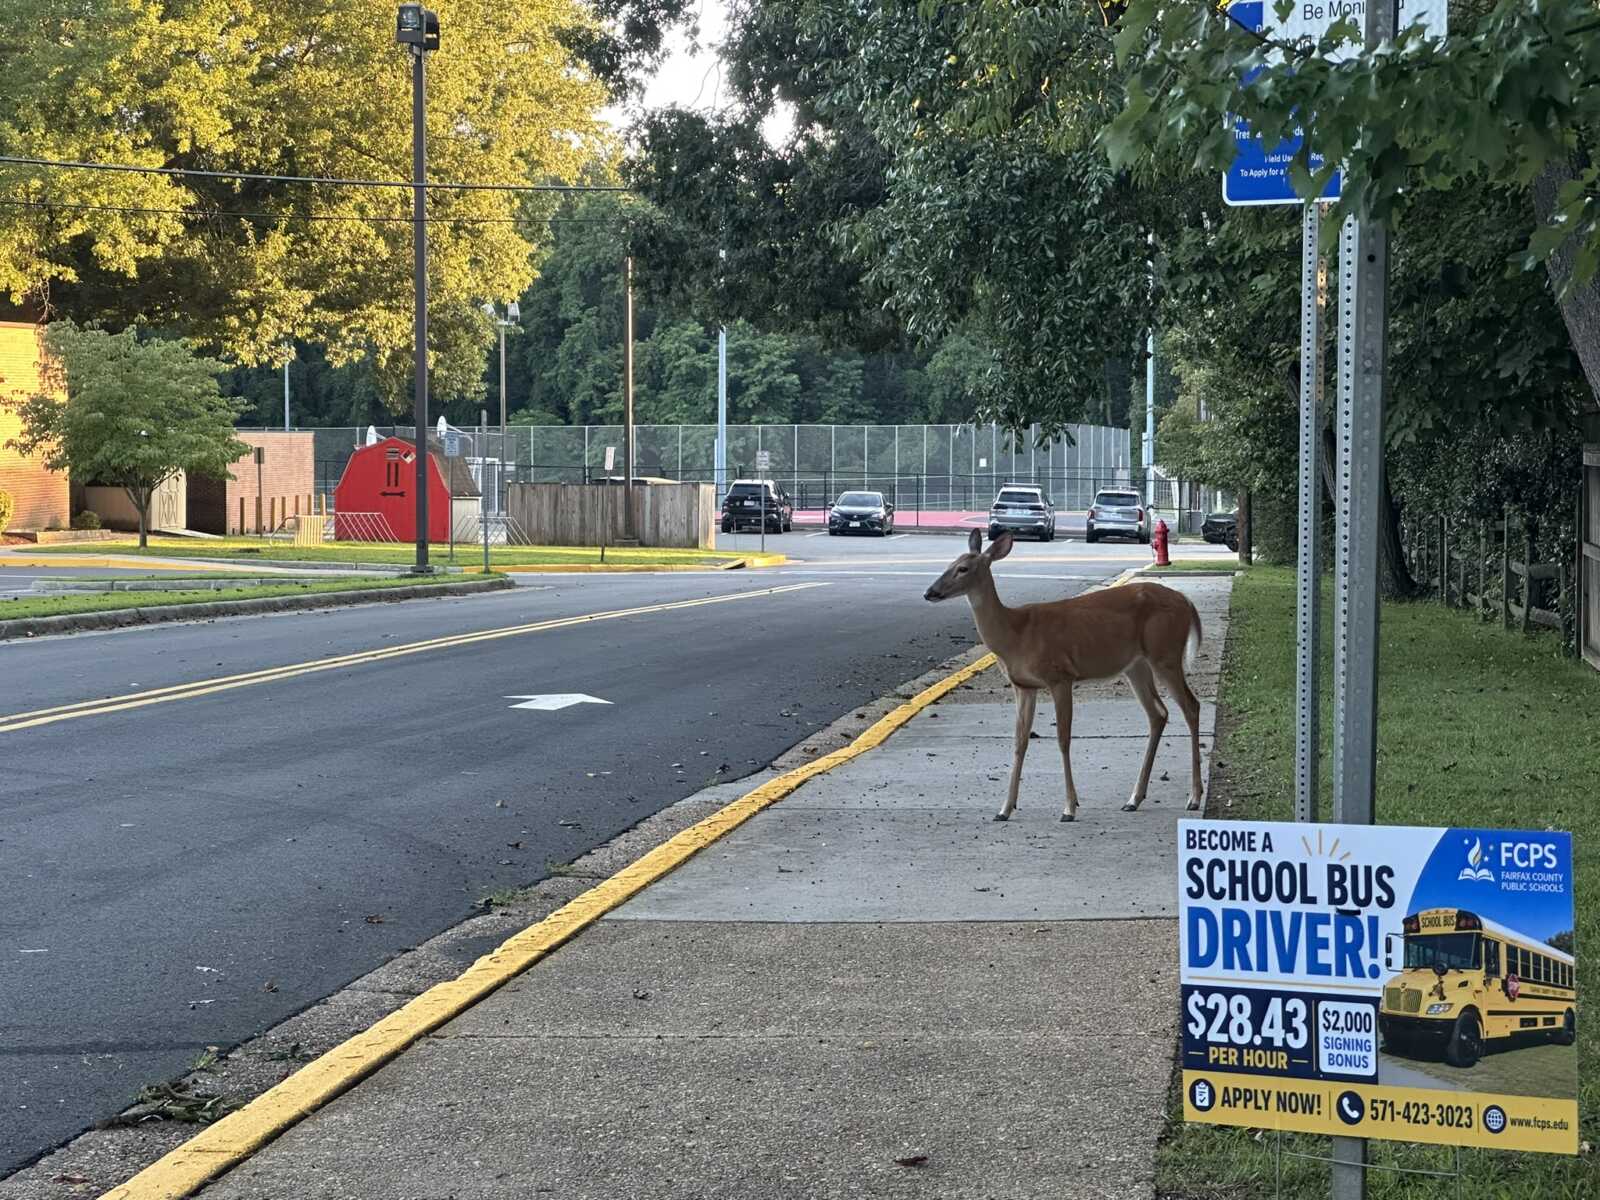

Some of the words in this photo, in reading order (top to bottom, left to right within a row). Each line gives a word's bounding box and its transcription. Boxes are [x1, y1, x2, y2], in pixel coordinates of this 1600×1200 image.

[1303, 4, 1323, 20] Be
[1240, 169, 1248, 177] To
[1248, 168, 1268, 178] Apply
[1269, 167, 1278, 176] for
[1186, 829, 1256, 852] BECOME
[1261, 832, 1273, 852] A
[1501, 842, 1557, 869] FCPS
[1186, 857, 1317, 904] SCHOOL
[1327, 863, 1396, 909] BUS
[1501, 871, 1531, 881] FAIRFAX
[1532, 872, 1563, 882] COUNTY
[1501, 883, 1527, 892] PUBLIC
[1528, 884, 1564, 893] SCHOOLS
[1421, 917, 1442, 928] SCHOOL
[1443, 915, 1456, 927] BUS
[1187, 906, 1381, 979] DRIVER!
[1187, 990, 1308, 1048] $28.43
[1322, 1008, 1372, 1033] $2,000
[1323, 1036, 1372, 1052] SIGNING
[1209, 1046, 1242, 1065] PER
[1243, 1049, 1288, 1069] HOUR
[1328, 1053, 1369, 1069] BONUS
[1221, 1086, 1272, 1112] APPLY
[1276, 1091, 1322, 1115] NOW!
[1370, 1099, 1473, 1129] 571-423-3023
[1510, 1116, 1568, 1131] www.fcps.edu
